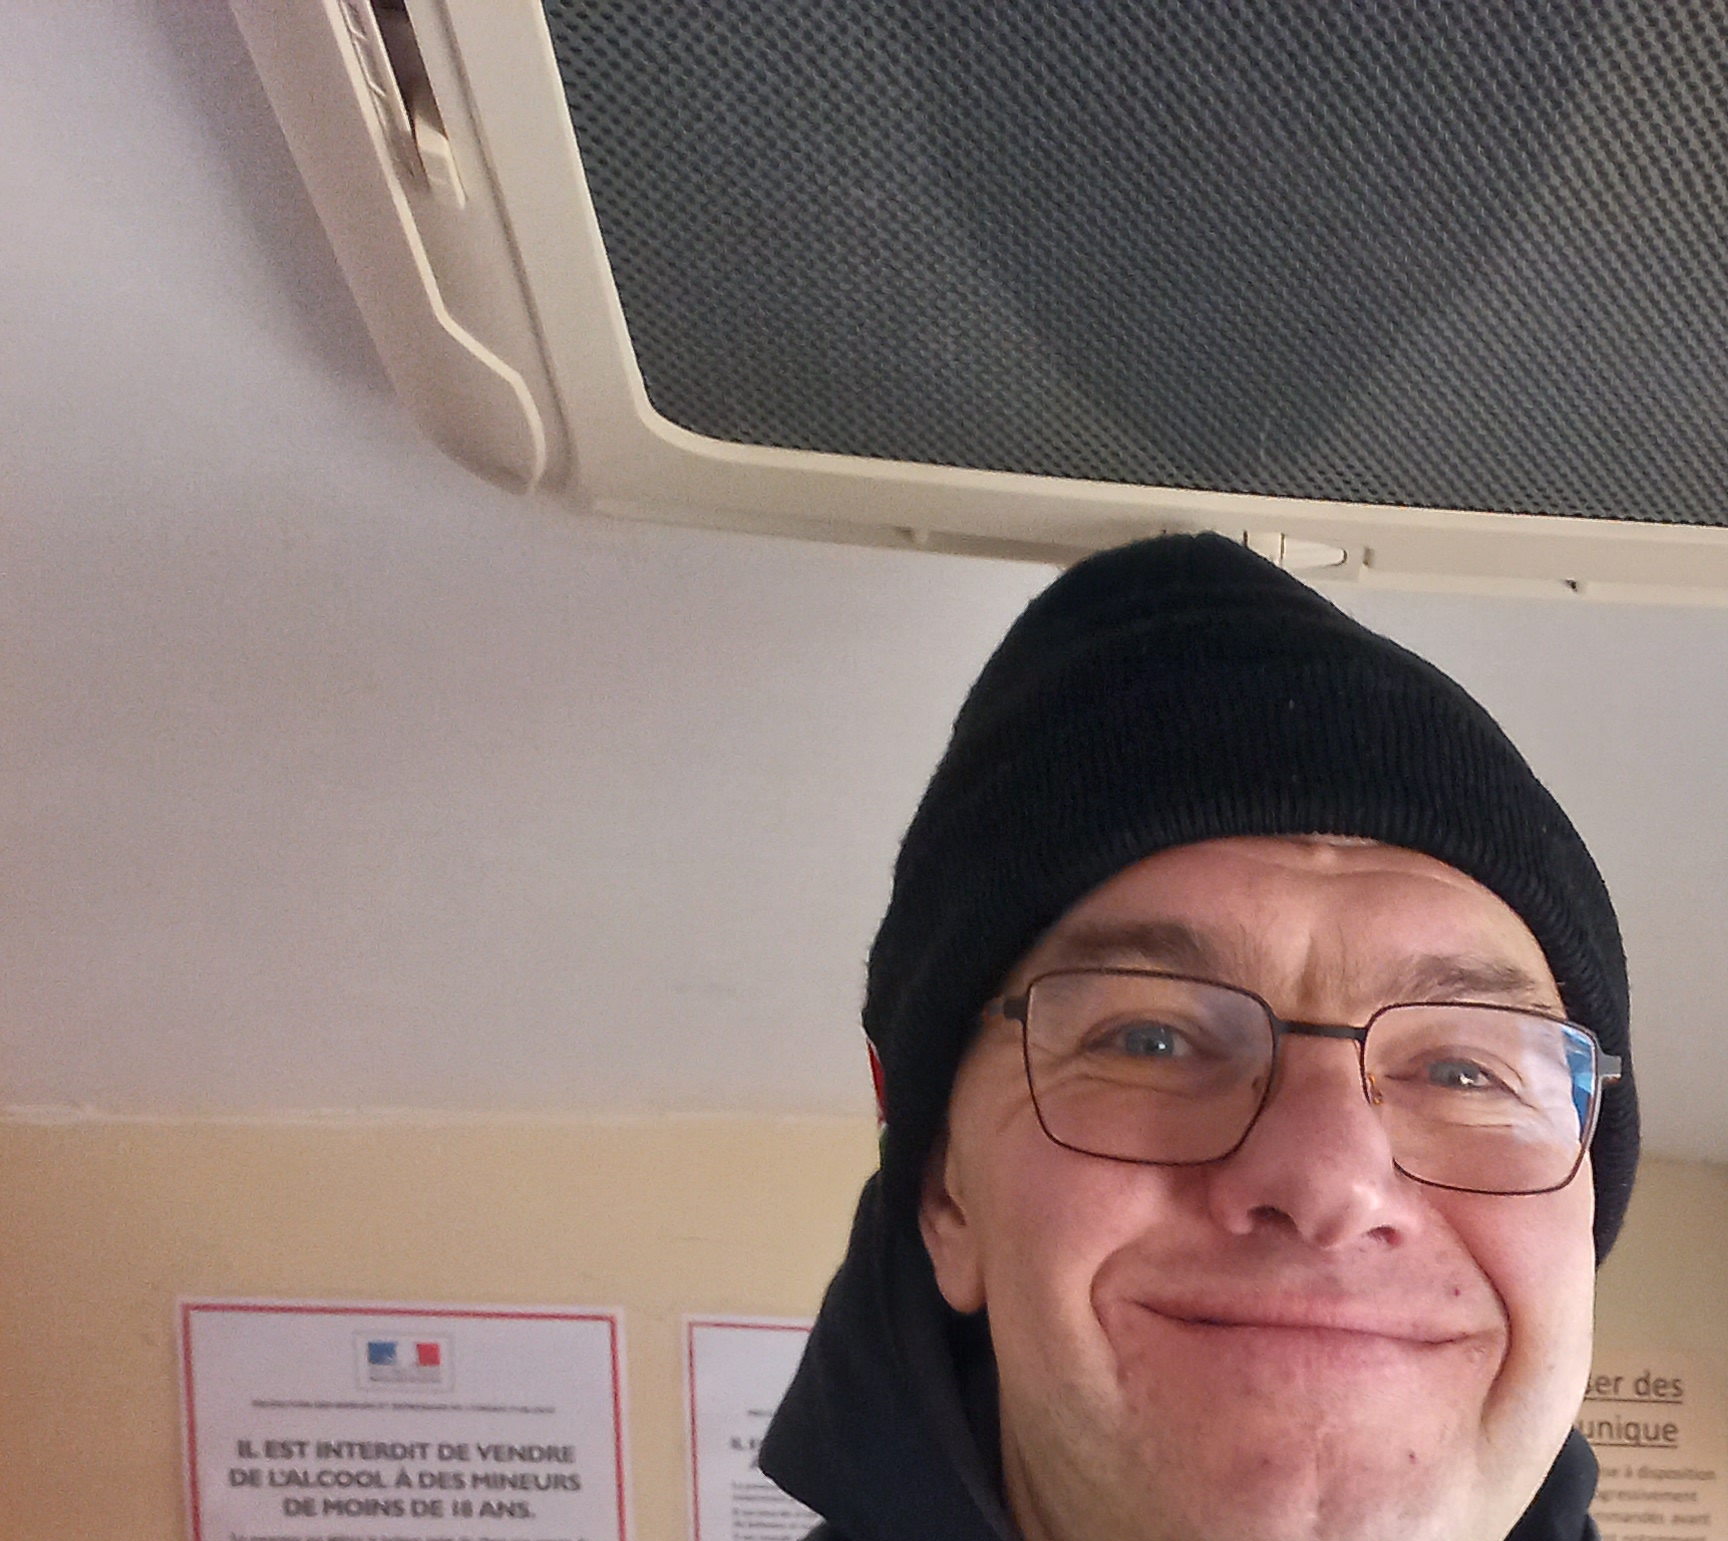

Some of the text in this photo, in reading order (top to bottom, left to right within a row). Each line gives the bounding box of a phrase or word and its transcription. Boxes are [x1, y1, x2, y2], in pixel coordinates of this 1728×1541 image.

[1634, 1370, 1683, 1398] des
[1580, 1415, 1679, 1445] unique
[236, 1438, 577, 1464] IL EST INTERDIT DE VENDRE
[229, 1464, 582, 1492] DE L'ALCOOL À DES MINEURS
[283, 1497, 537, 1520] DE MOINS DE 18 ANS.
